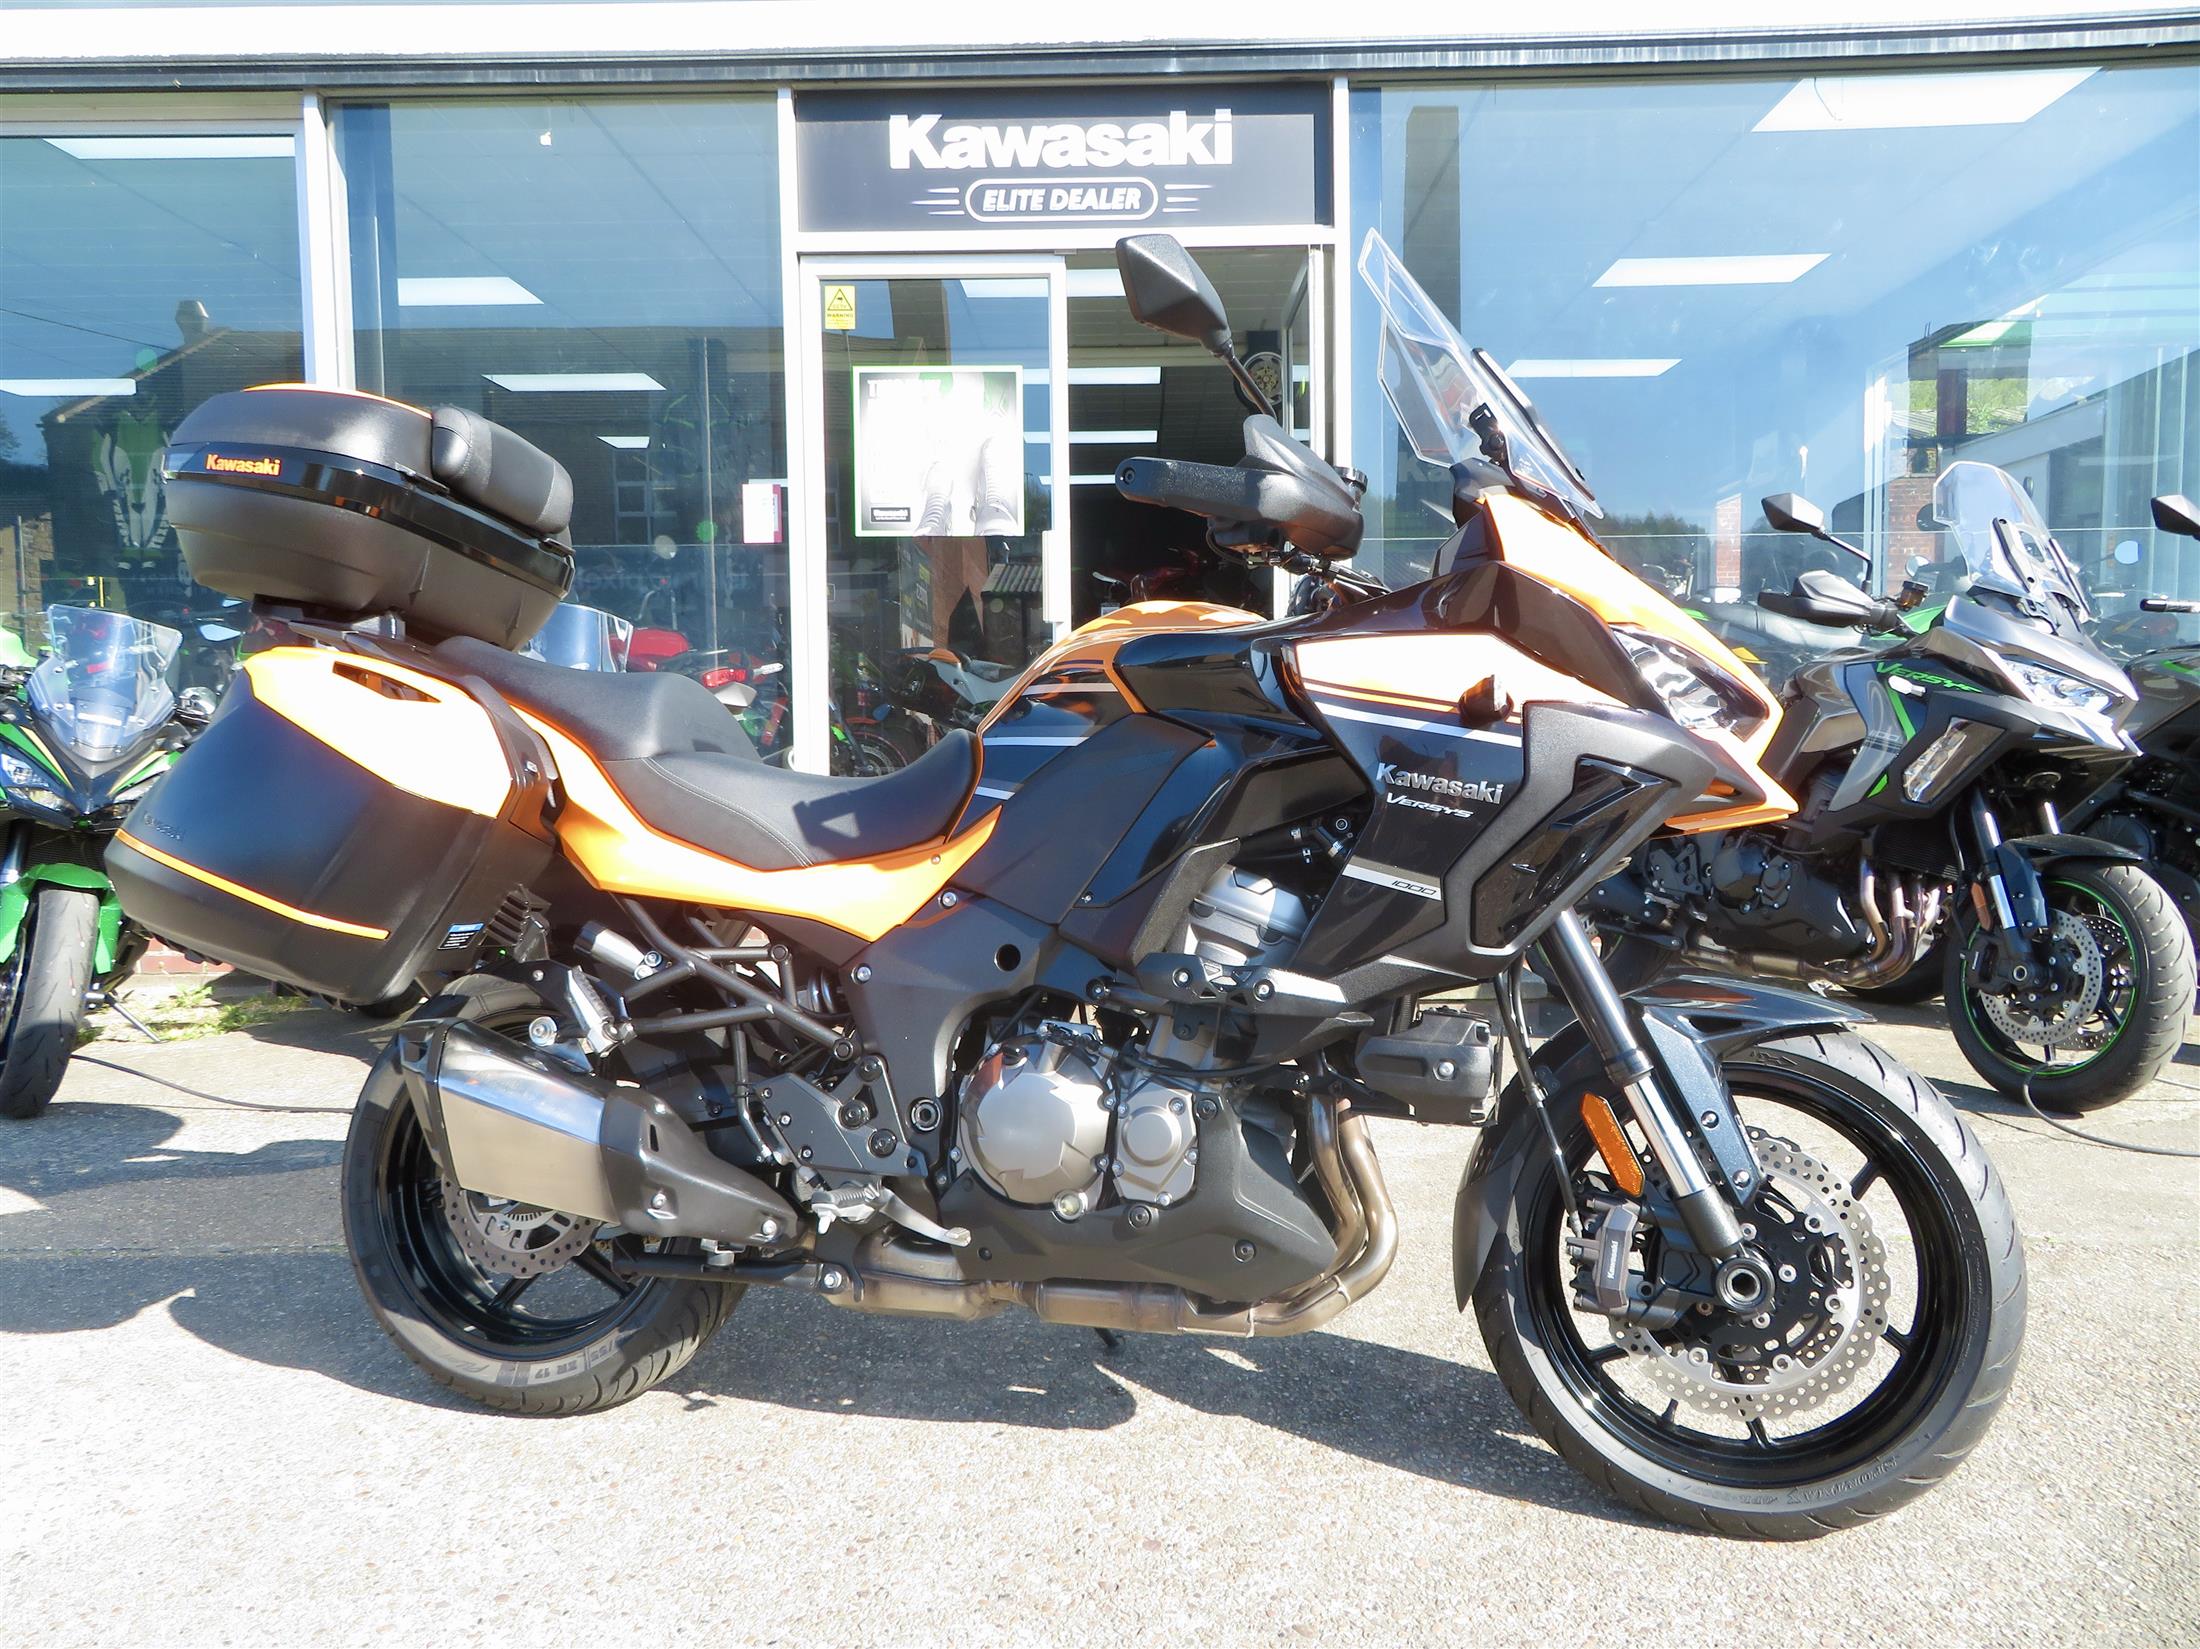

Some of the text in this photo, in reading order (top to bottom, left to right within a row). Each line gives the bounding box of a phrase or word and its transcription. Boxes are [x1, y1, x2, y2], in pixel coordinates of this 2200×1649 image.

[889, 108, 1233, 170] Kawasaki
[982, 186, 1142, 212] ELITE DEALER
[205, 453, 281, 476] Kawasaki
[1375, 762, 1504, 805] Kawasaki
[1391, 879, 1437, 897] 1000
